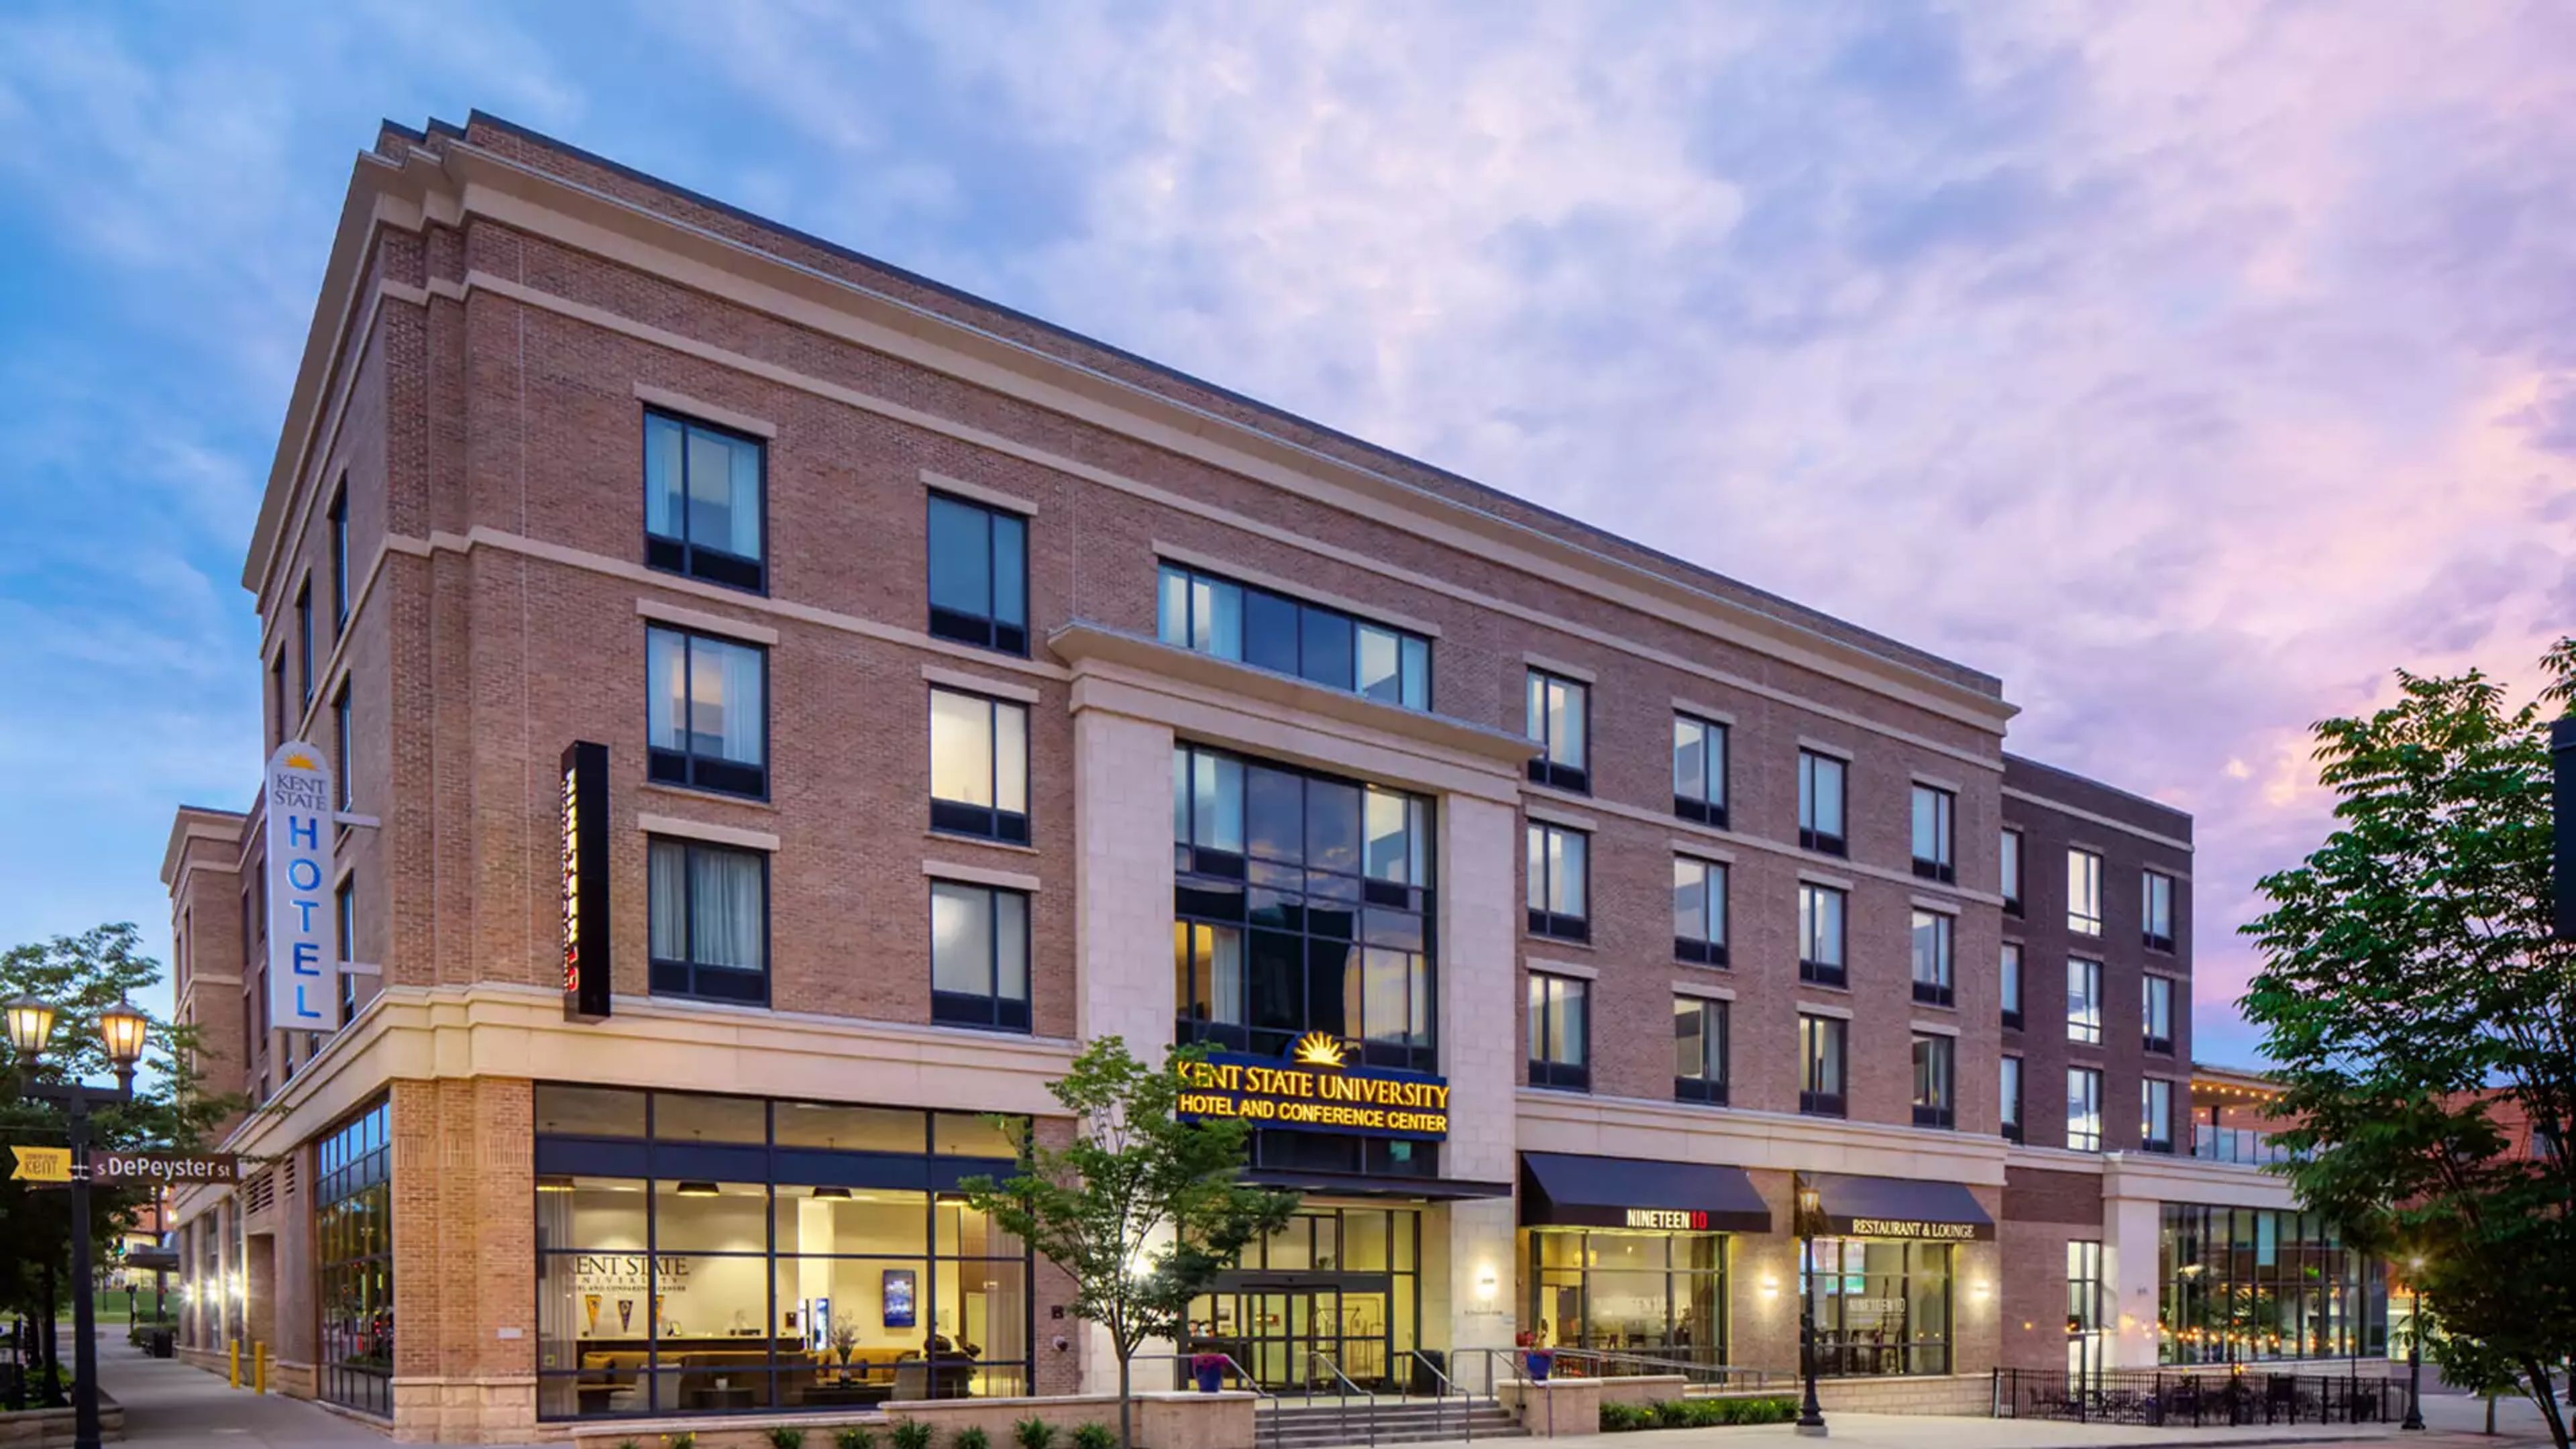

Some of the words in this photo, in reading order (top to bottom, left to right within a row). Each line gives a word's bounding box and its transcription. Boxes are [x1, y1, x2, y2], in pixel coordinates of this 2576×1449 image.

[276, 773, 327, 795] KENT
[274, 790, 327, 811] STATE
[287, 815, 322, 1018] HOTEL
[1177, 1061, 1243, 1091] KENT
[1245, 1066, 1313, 1097] STATE
[1320, 1073, 1450, 1109] UNIVERSITY
[1180, 1093, 1236, 1116] HOTEL
[1239, 1099, 1275, 1118] AND
[1278, 1102, 1384, 1128] CONFERENCE
[1387, 1112, 1448, 1132] CENTER
[108, 1157, 215, 1181] DePeyster
[1627, 1209, 1708, 1230] NINETEEN10
[1852, 1219, 1922, 1236] RESTAURANT
[1922, 1222, 1931, 1238] &
[1932, 1224, 1975, 1238] LOUNGE
